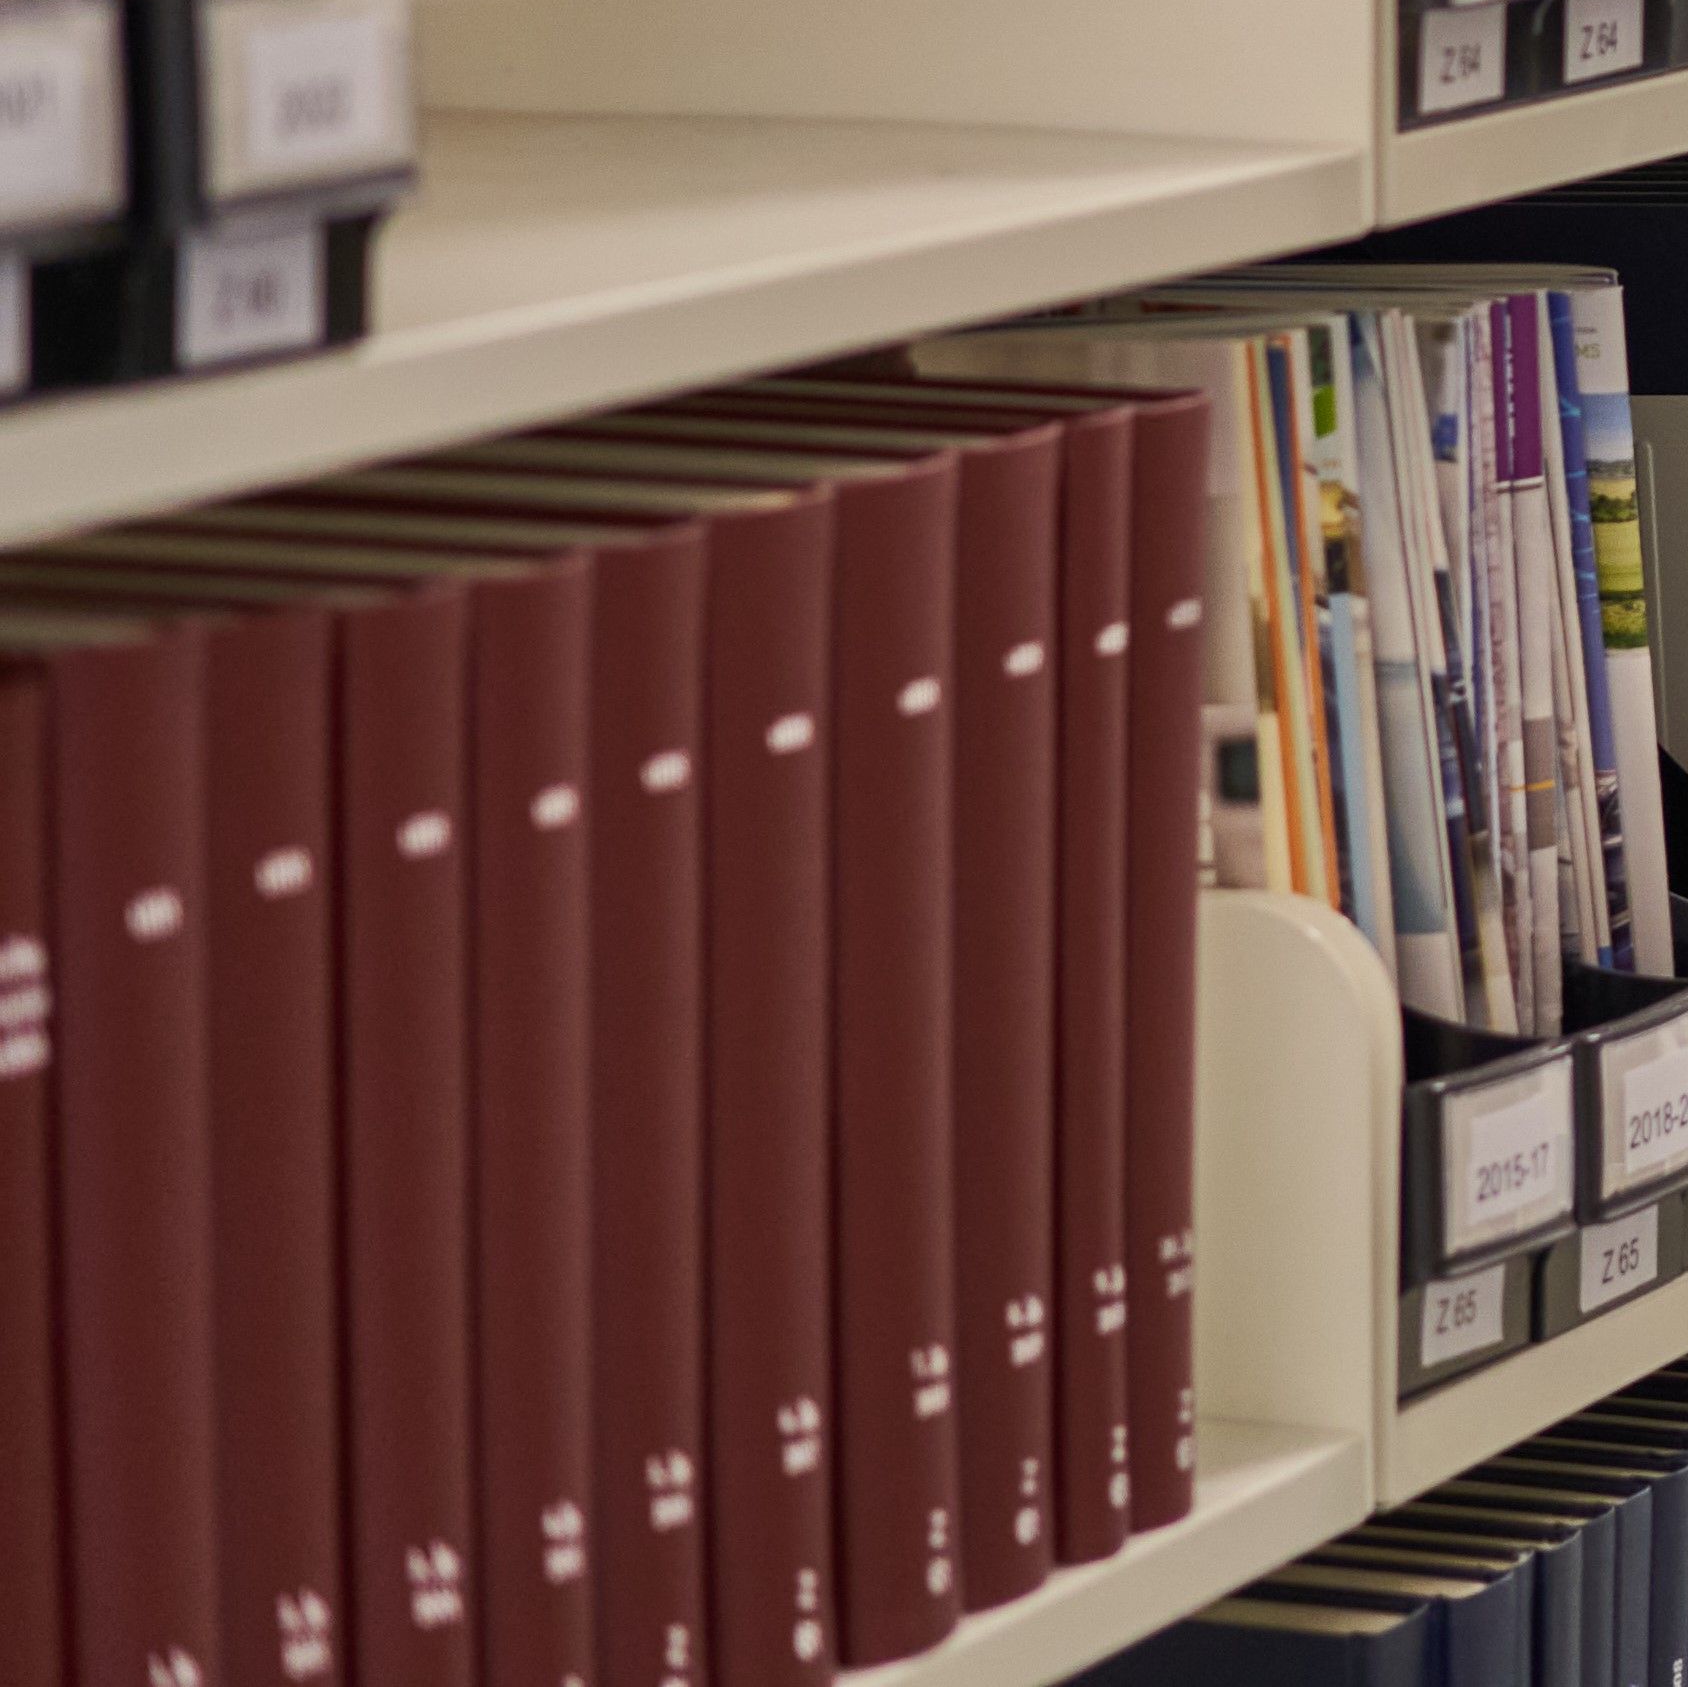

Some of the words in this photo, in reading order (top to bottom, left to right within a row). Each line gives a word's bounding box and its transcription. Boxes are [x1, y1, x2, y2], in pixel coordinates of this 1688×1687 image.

[1476, 1142, 1550, 1203] 2015-17
[1602, 1252, 1616, 1285] Z
[1617, 1238, 1640, 1277] 65
[1436, 1303, 1451, 1336] Z
[1452, 1289, 1477, 1330] 65
